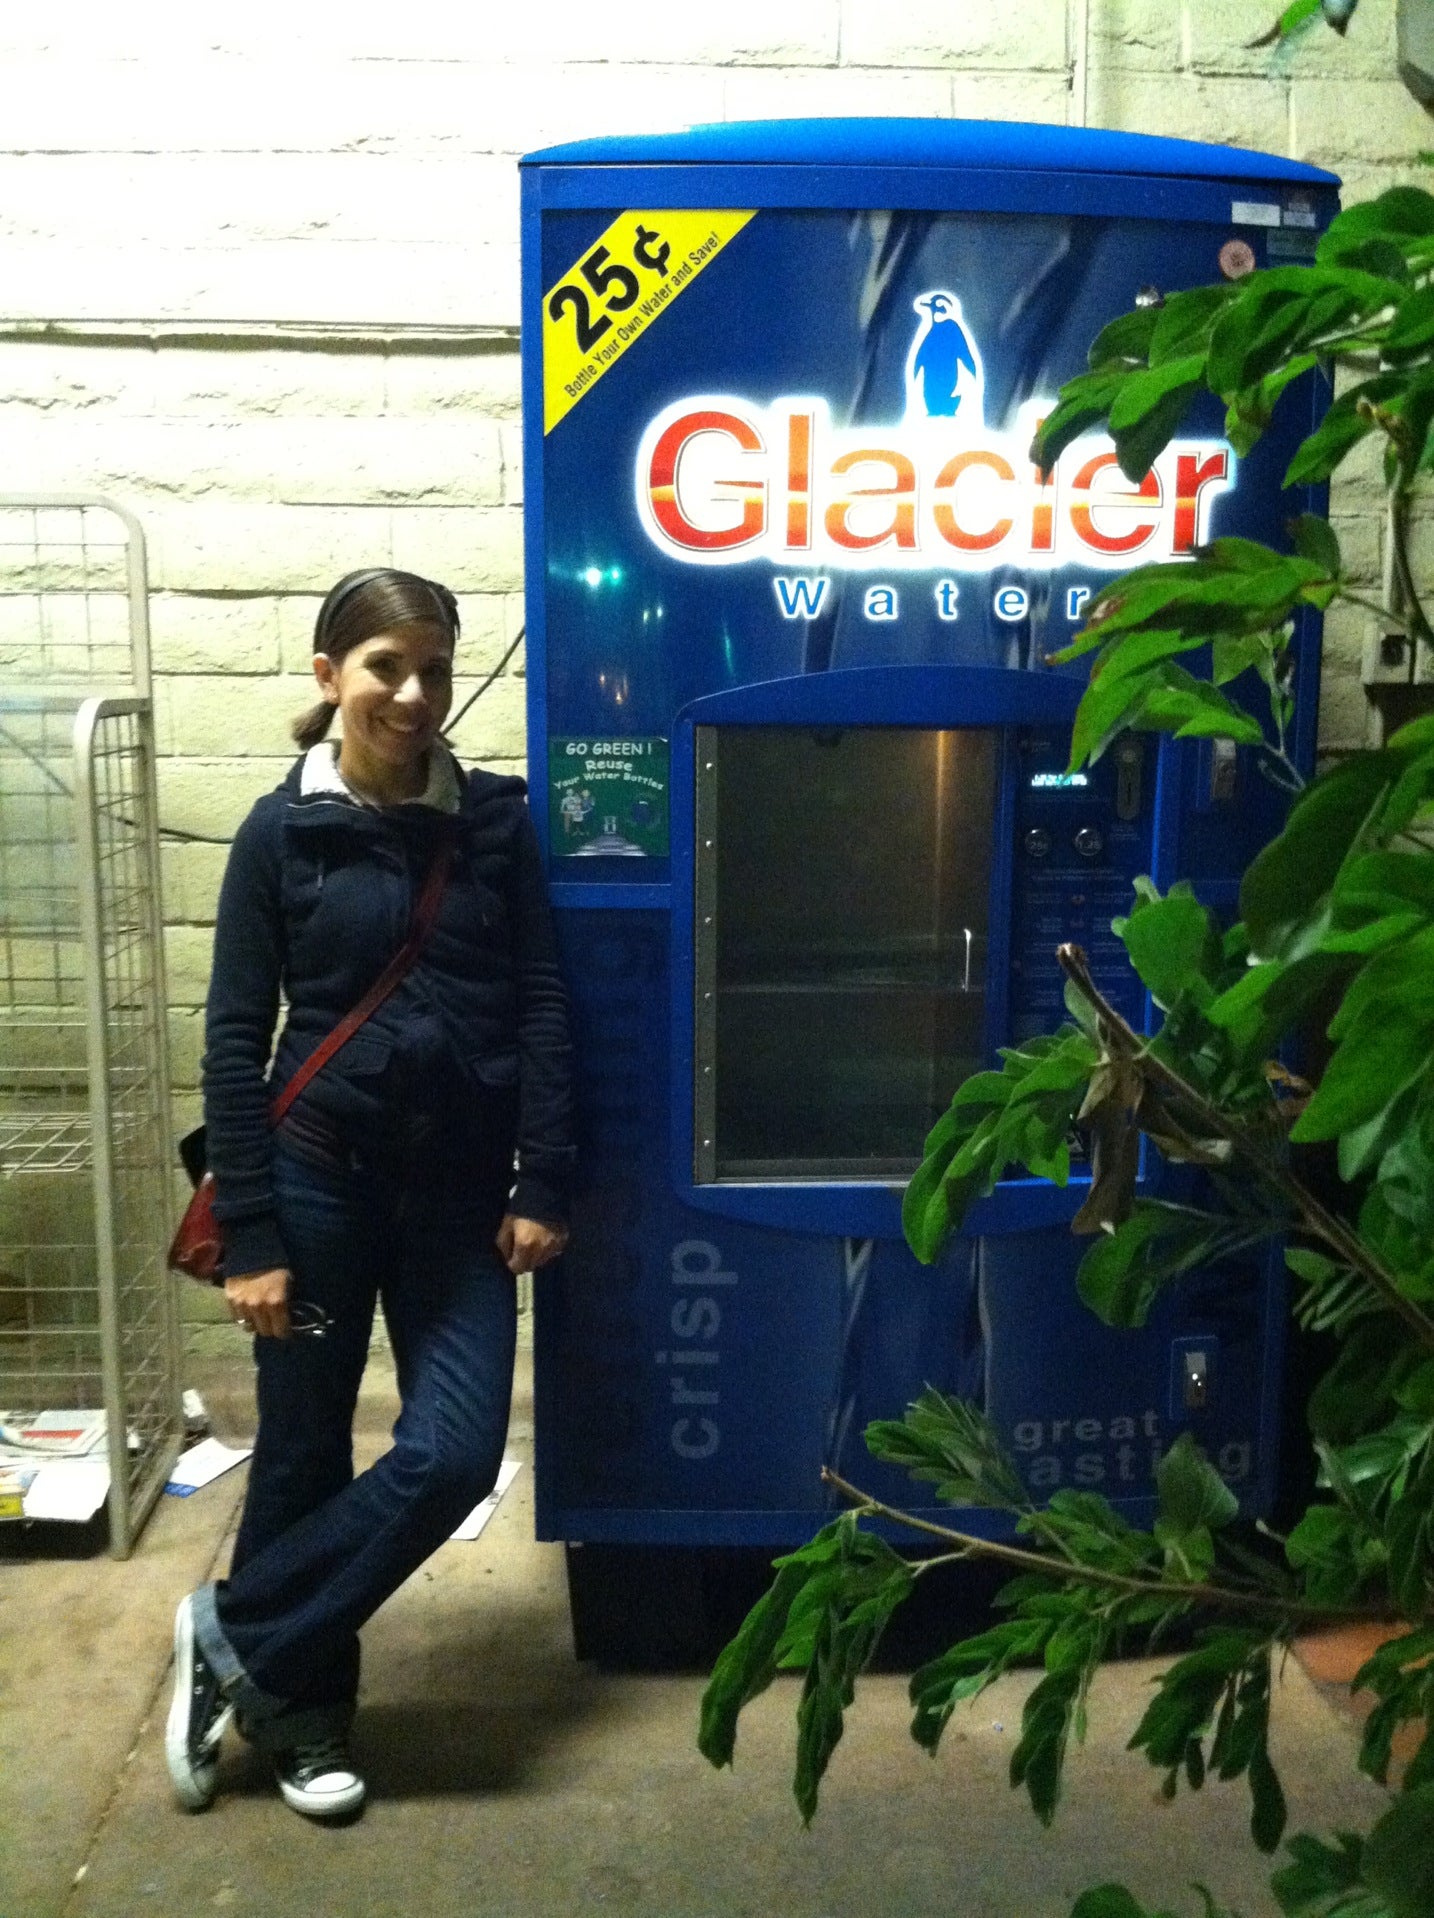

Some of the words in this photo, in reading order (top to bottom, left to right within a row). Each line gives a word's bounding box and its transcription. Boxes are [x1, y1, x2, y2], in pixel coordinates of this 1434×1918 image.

[564, 364, 598, 398] Bottle
[593, 337, 620, 366] Your
[616, 315, 644, 342] Own
[638, 283, 673, 318] Water
[670, 261, 694, 286] and
[688, 231, 721, 266] Save!
[648, 409, 1228, 556] Glacier
[775, 577, 1089, 618] Water
[566, 742, 588, 755] GO
[592, 742, 643, 755] GREEN
[585, 759, 633, 772] Reuse
[553, 776, 580, 789] Your
[583, 772, 620, 781] Water
[655, 1239, 739, 1459] crisp
[1013, 1410, 1159, 1451] great
